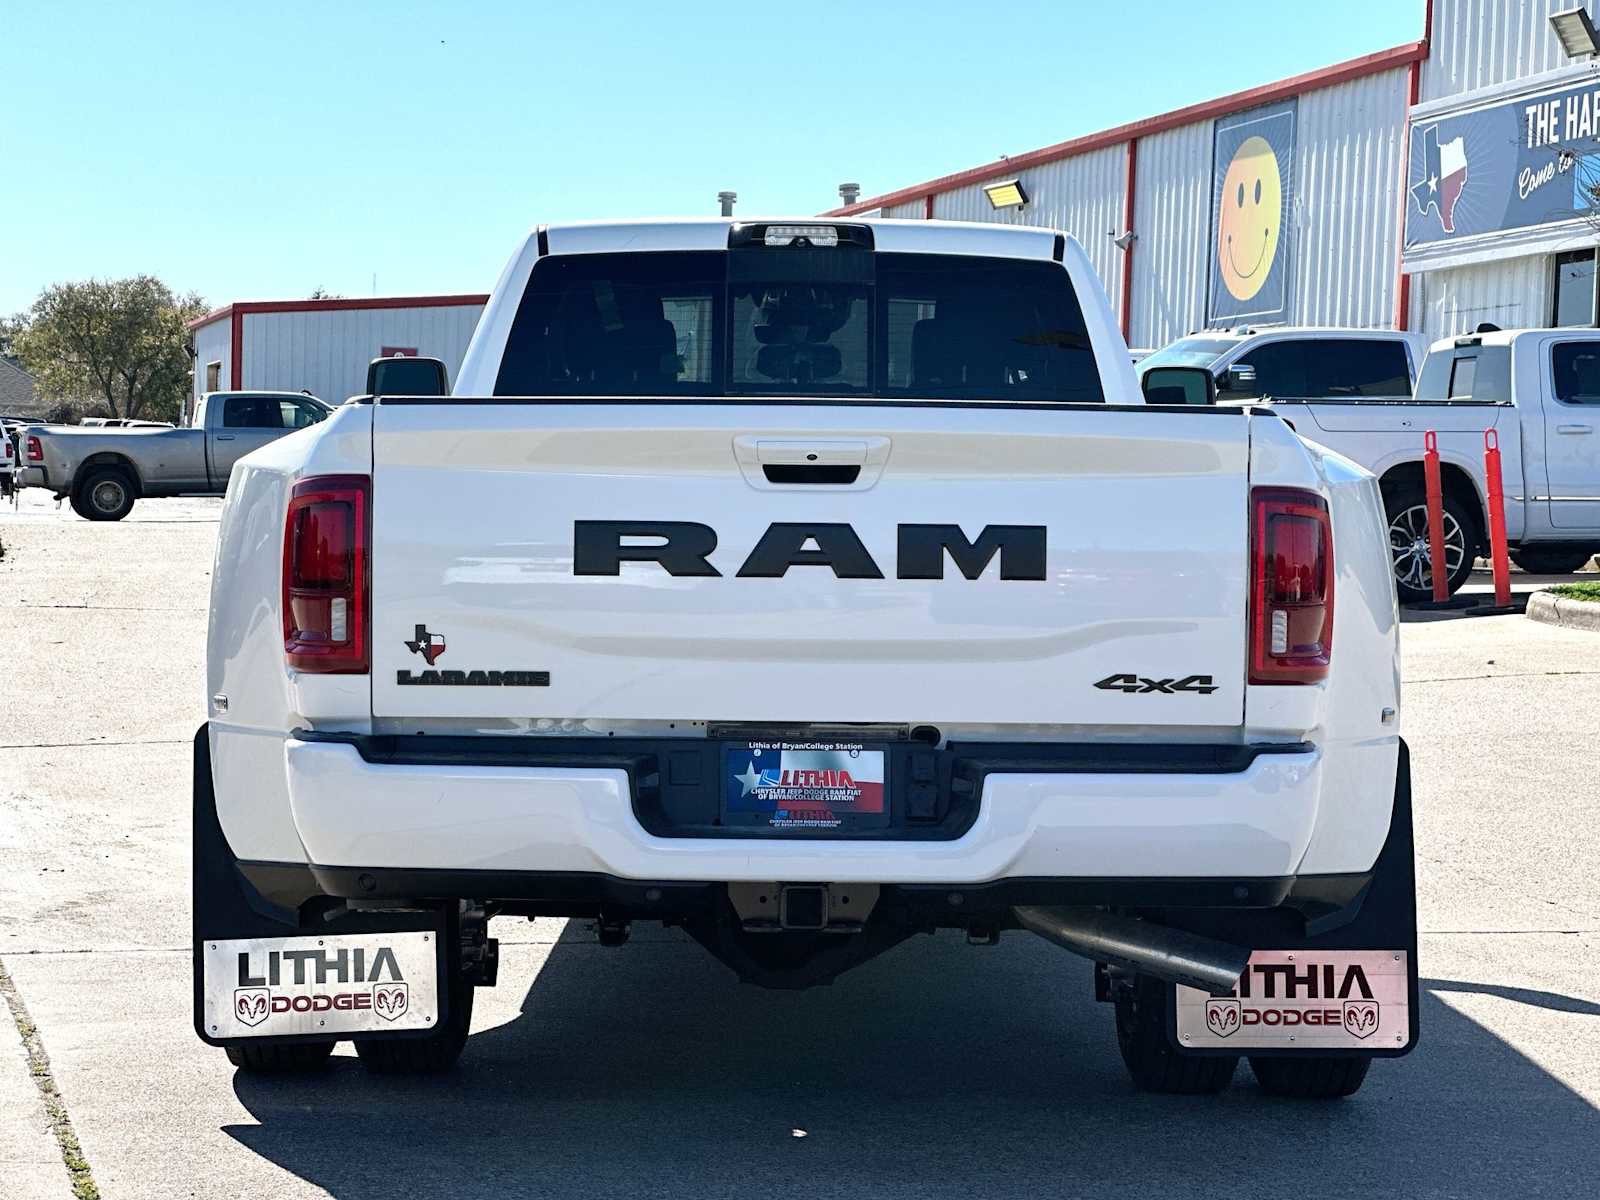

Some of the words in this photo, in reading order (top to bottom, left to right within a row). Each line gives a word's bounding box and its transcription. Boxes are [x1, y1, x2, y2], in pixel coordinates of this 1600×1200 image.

[1525, 99, 1560, 149] THE
[1519, 161, 1555, 200] Come
[573, 519, 1047, 581] RAM
[396, 669, 551, 687] LARAMIE
[748, 741, 770, 750] Lithia
[771, 741, 781, 749] of
[781, 742, 834, 751] Bryan/College
[835, 742, 863, 750] Station
[780, 769, 857, 789] LITHIA
[237, 947, 404, 987] LITHIA
[1210, 964, 1374, 999] ITHIA
[271, 993, 372, 1013] DODGE
[1242, 1008, 1342, 1026] DODGE
